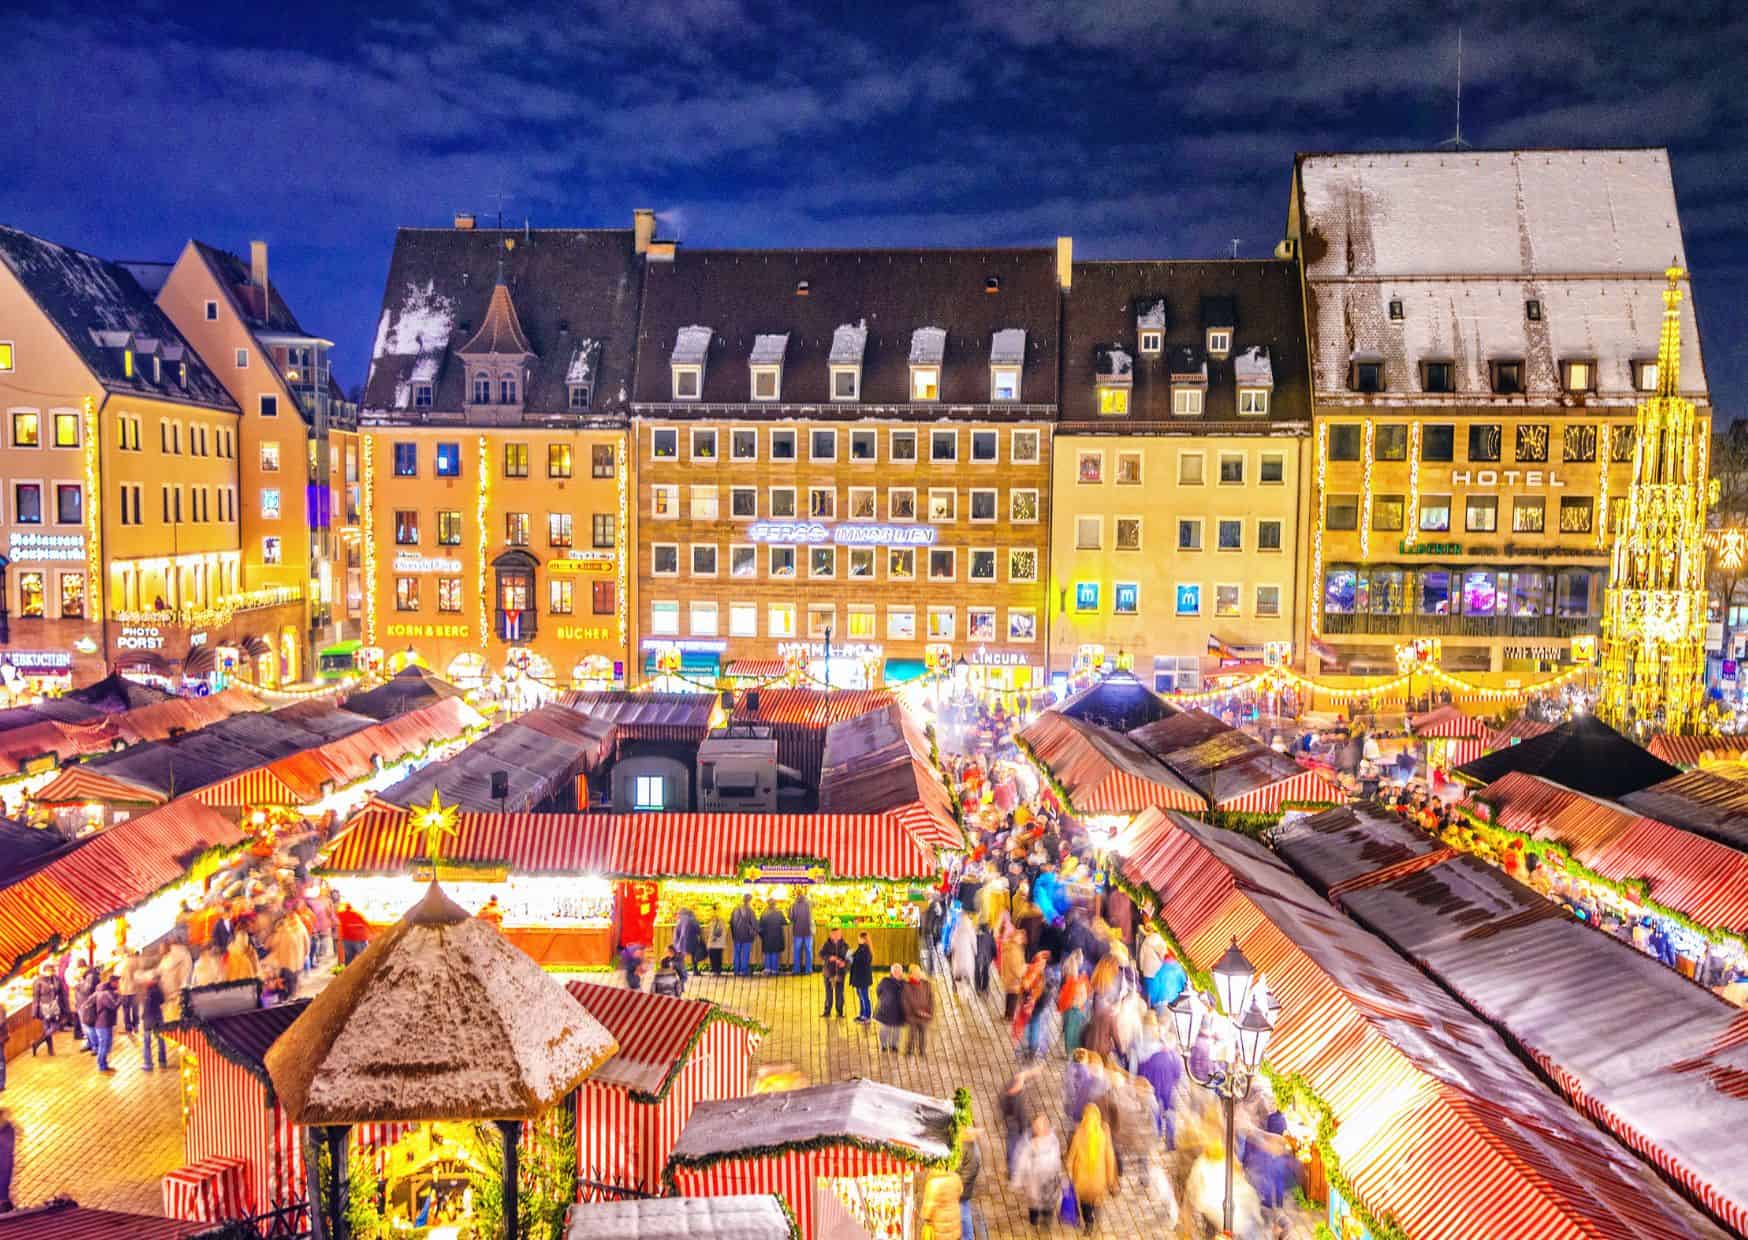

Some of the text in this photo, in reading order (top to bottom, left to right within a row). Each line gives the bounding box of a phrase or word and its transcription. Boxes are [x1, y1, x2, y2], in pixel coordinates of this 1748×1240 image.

[1452, 470, 1565, 487] HOTEL
[122, 628, 159, 636] PHOTO
[387, 625, 469, 637] KORN & BERG
[558, 625, 609, 640] BÜCHER
[117, 637, 164, 648] PORST
